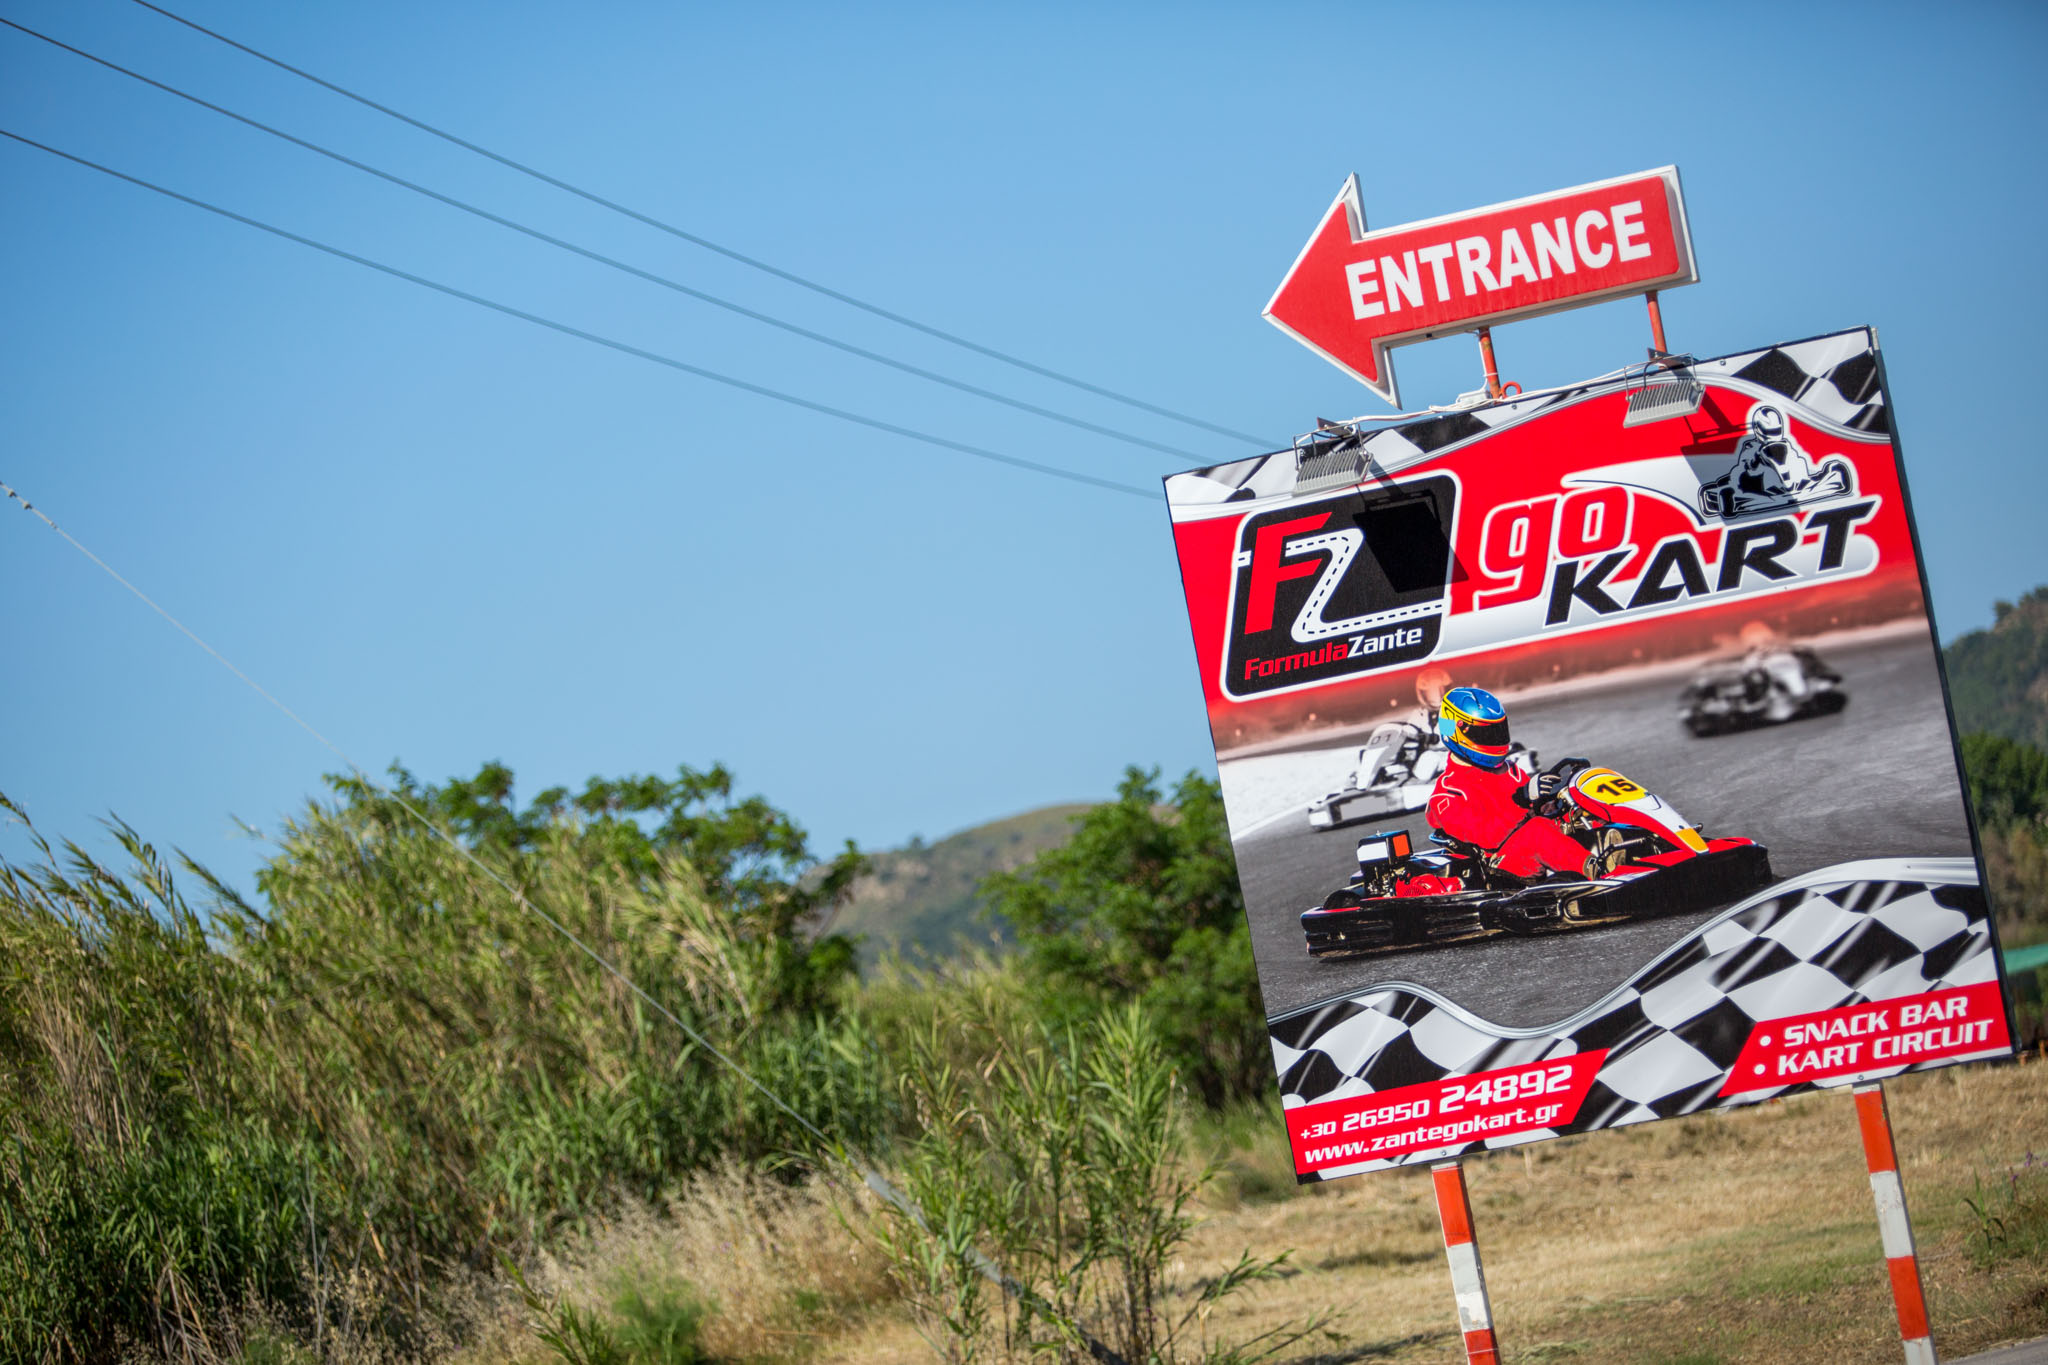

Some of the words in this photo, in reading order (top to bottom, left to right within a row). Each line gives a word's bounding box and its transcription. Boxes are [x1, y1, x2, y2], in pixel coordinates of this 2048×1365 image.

[1344, 200, 1652, 320] ENTRANCE
[1478, 486, 1631, 611] go
[1545, 501, 1876, 626] KART
[1244, 627, 1423, 680] FormulaZante
[1596, 778, 1638, 797] 15
[1777, 1042, 1863, 1076] KART
[1872, 1019, 1994, 1059] CIRCUIT
[1784, 1010, 1889, 1047] SNACK
[1900, 996, 1968, 1028] BAR
[1300, 1120, 1336, 1139] +30
[1342, 1099, 1430, 1132] 26950
[1439, 1064, 1572, 1114] 24892
[1304, 1103, 1563, 1163] www.zantegokart.gr
